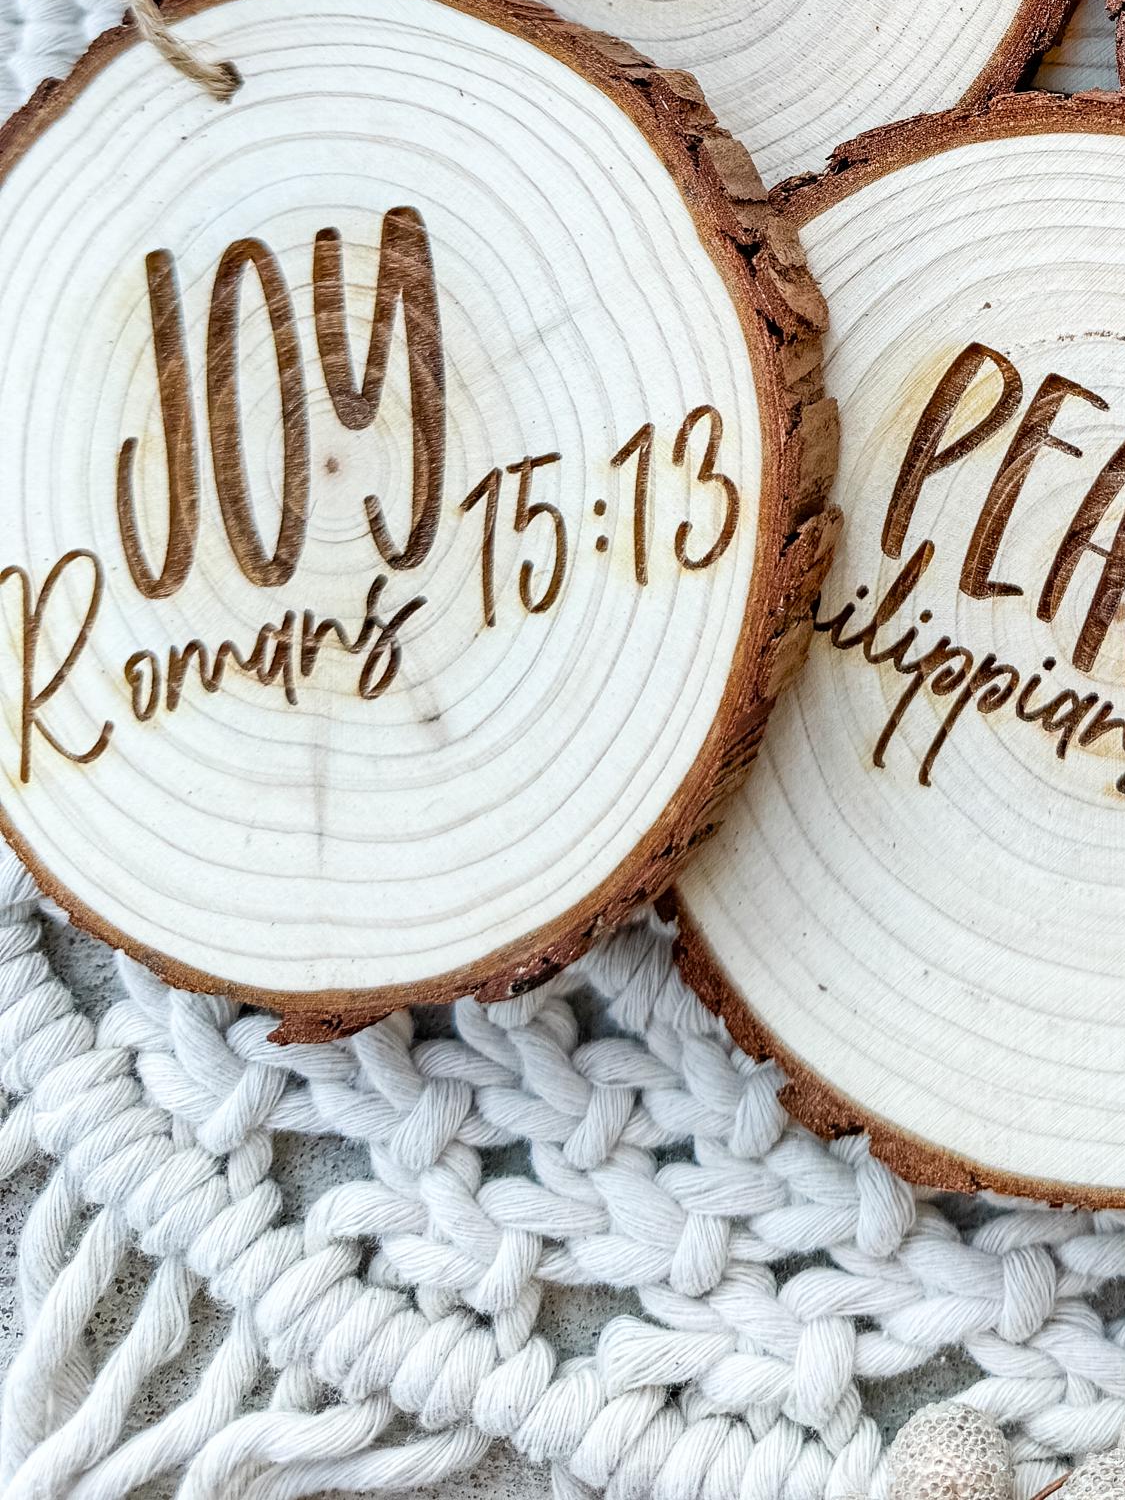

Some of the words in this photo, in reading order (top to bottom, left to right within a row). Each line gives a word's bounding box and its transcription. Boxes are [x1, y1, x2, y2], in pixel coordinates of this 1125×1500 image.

[0, 548, 429, 784] Romans
[459, 403, 741, 627] 15:13
[116, 204, 447, 600] JOY
